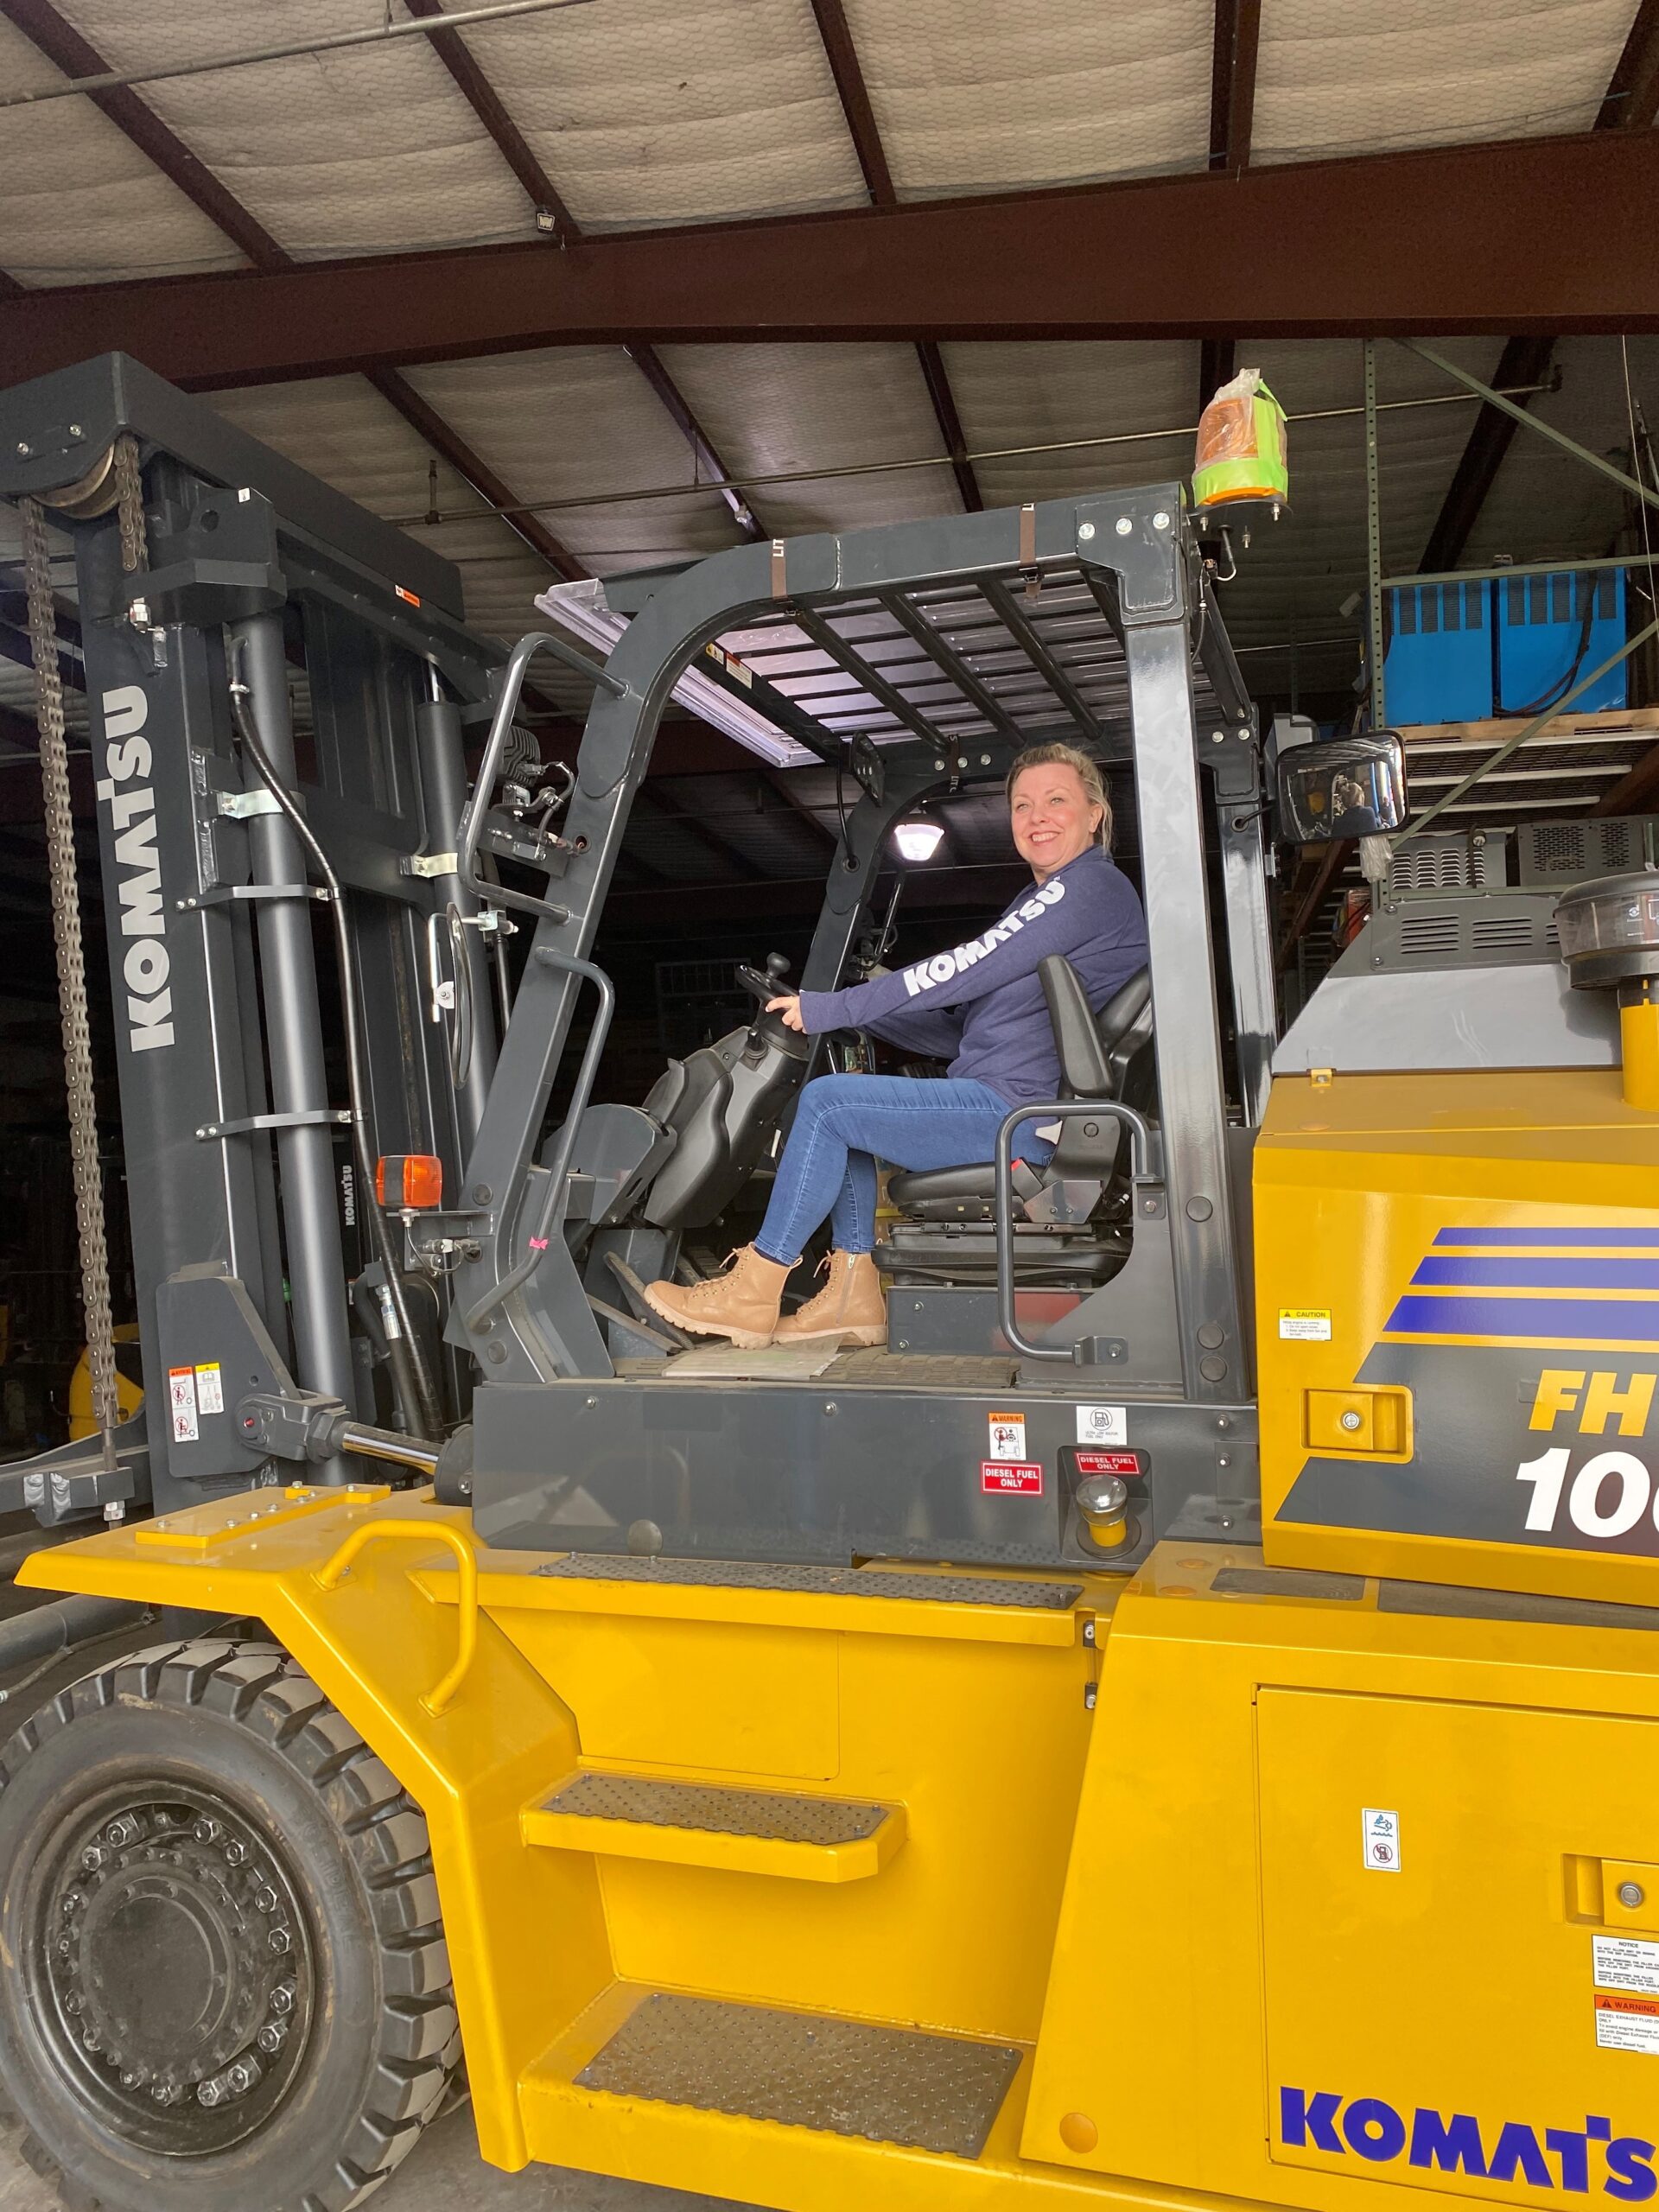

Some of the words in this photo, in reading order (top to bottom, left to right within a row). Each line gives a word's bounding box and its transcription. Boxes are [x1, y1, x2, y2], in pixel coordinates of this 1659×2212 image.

[97, 685, 175, 1052] KOMATSU
[903, 881, 1066, 996] KOMATSU
[341, 1165, 355, 1226] KOMATSU
[1528, 1369, 1657, 1437] FH
[985, 1468, 1014, 1478] DIESEL
[1017, 1469, 1039, 1479] FUEL
[1001, 1478, 1023, 1488] ONLY
[1516, 1447, 1659, 1538] 10
[1615, 2001, 1656, 2012] WARNING
[1281, 2085, 1658, 2202] KOMATS
